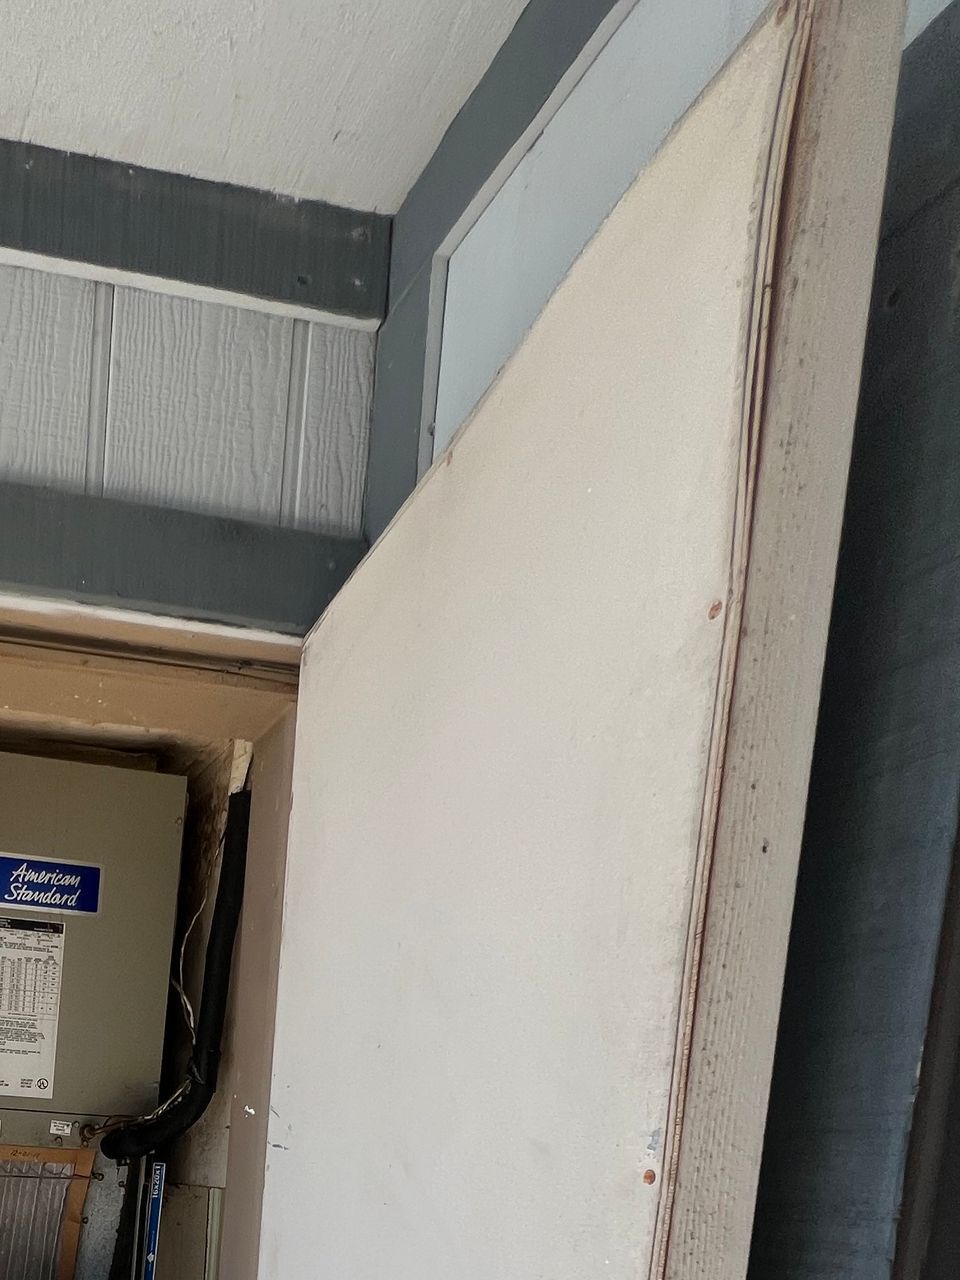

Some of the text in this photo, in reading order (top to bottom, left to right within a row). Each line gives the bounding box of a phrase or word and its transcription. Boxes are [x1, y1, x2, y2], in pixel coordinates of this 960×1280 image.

[10, 862, 81, 887] American
[4, 883, 81, 906] Standard
[152, 1165, 161, 1198] 16x20x1
